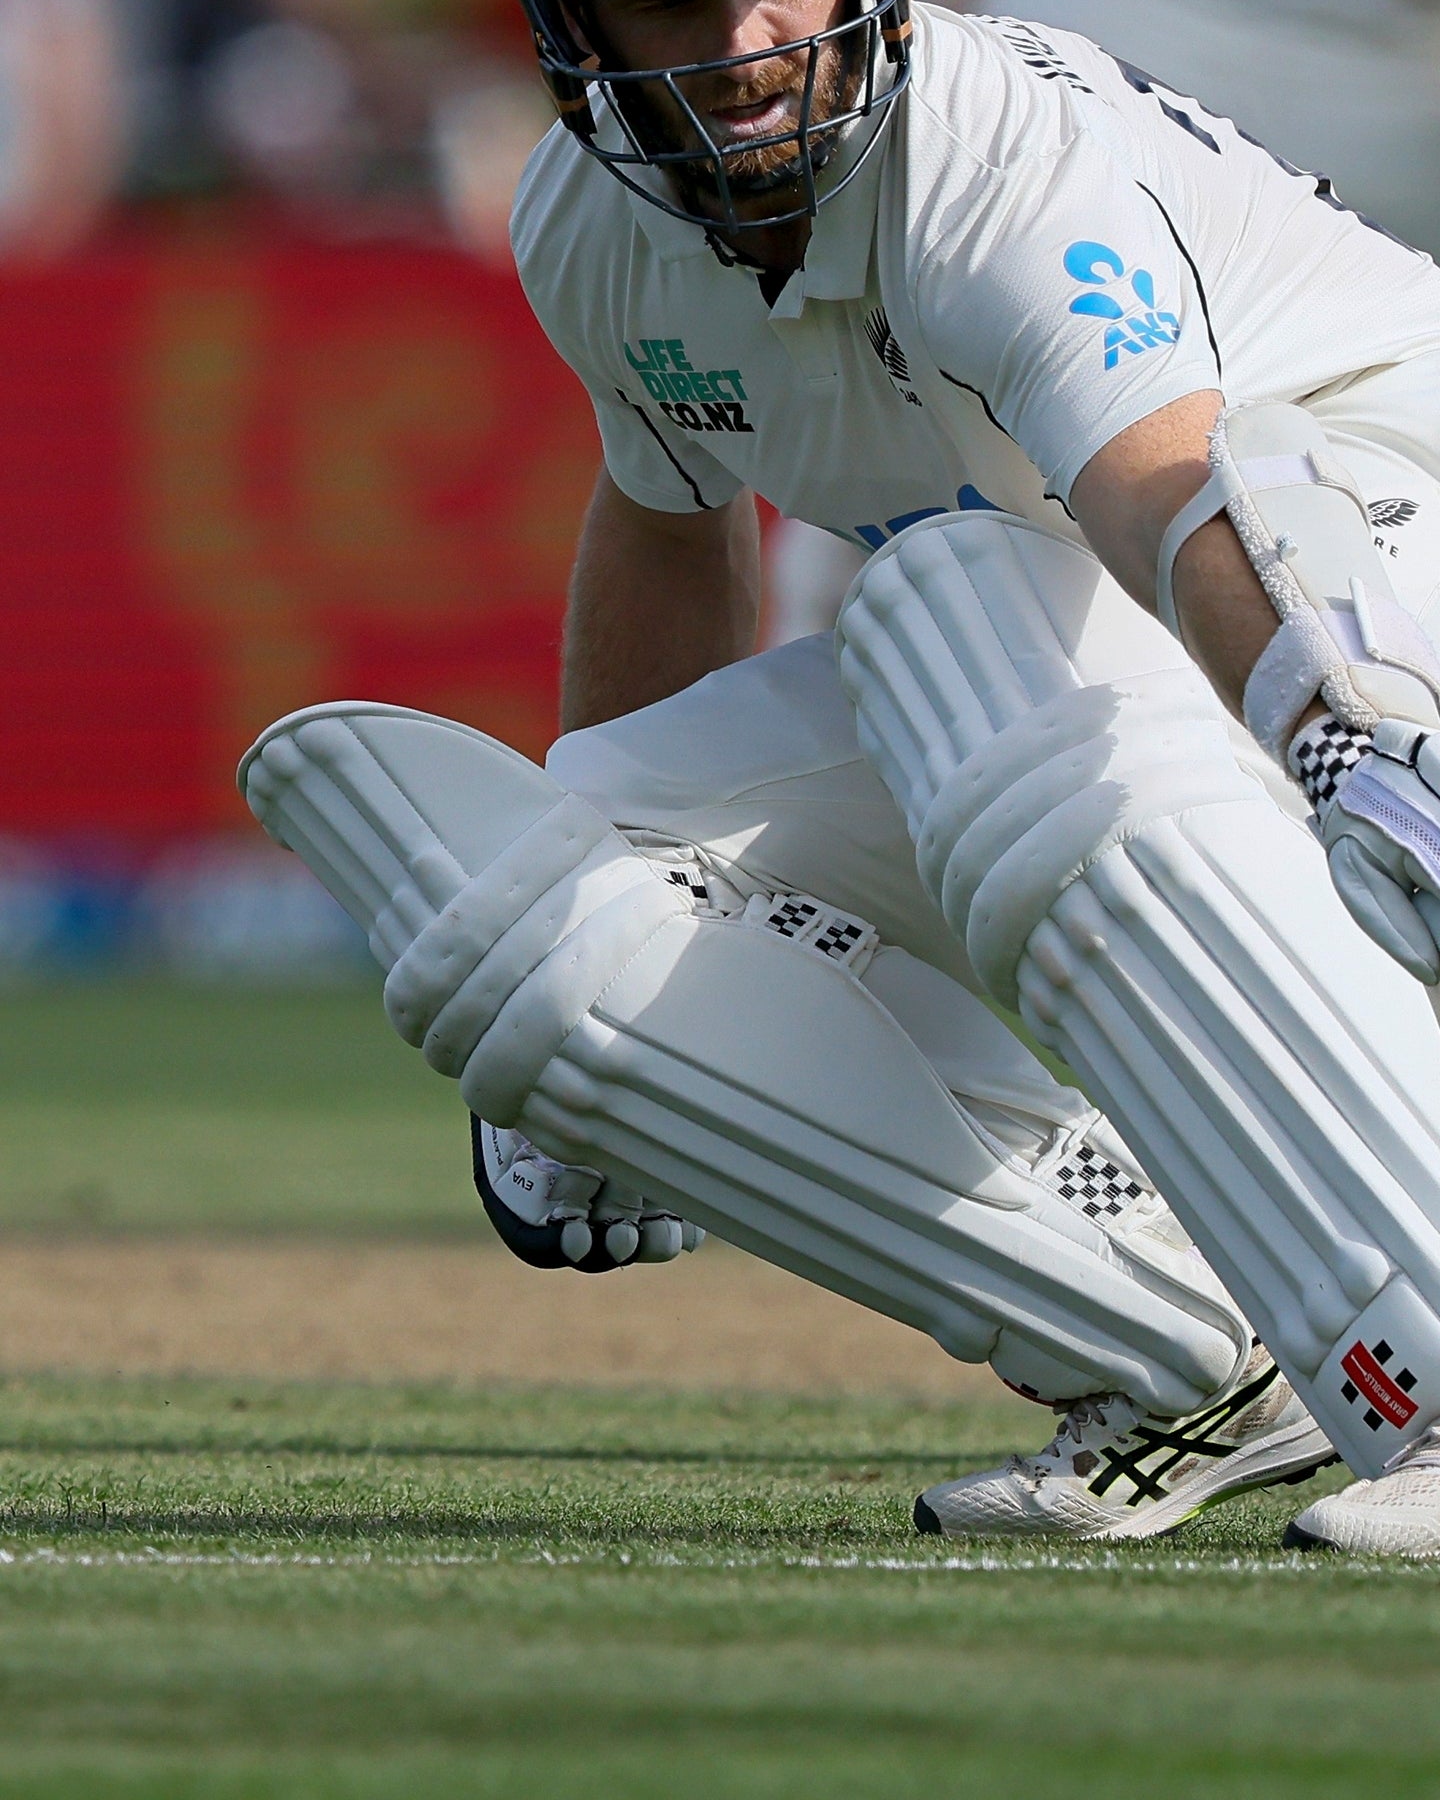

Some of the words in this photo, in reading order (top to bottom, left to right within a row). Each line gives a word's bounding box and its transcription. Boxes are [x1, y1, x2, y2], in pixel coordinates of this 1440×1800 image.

[624, 339, 694, 372] LIFE
[638, 369, 749, 402] DIRECT
[658, 402, 755, 433] CO.NZ
[512, 1171, 535, 1192] EVA
